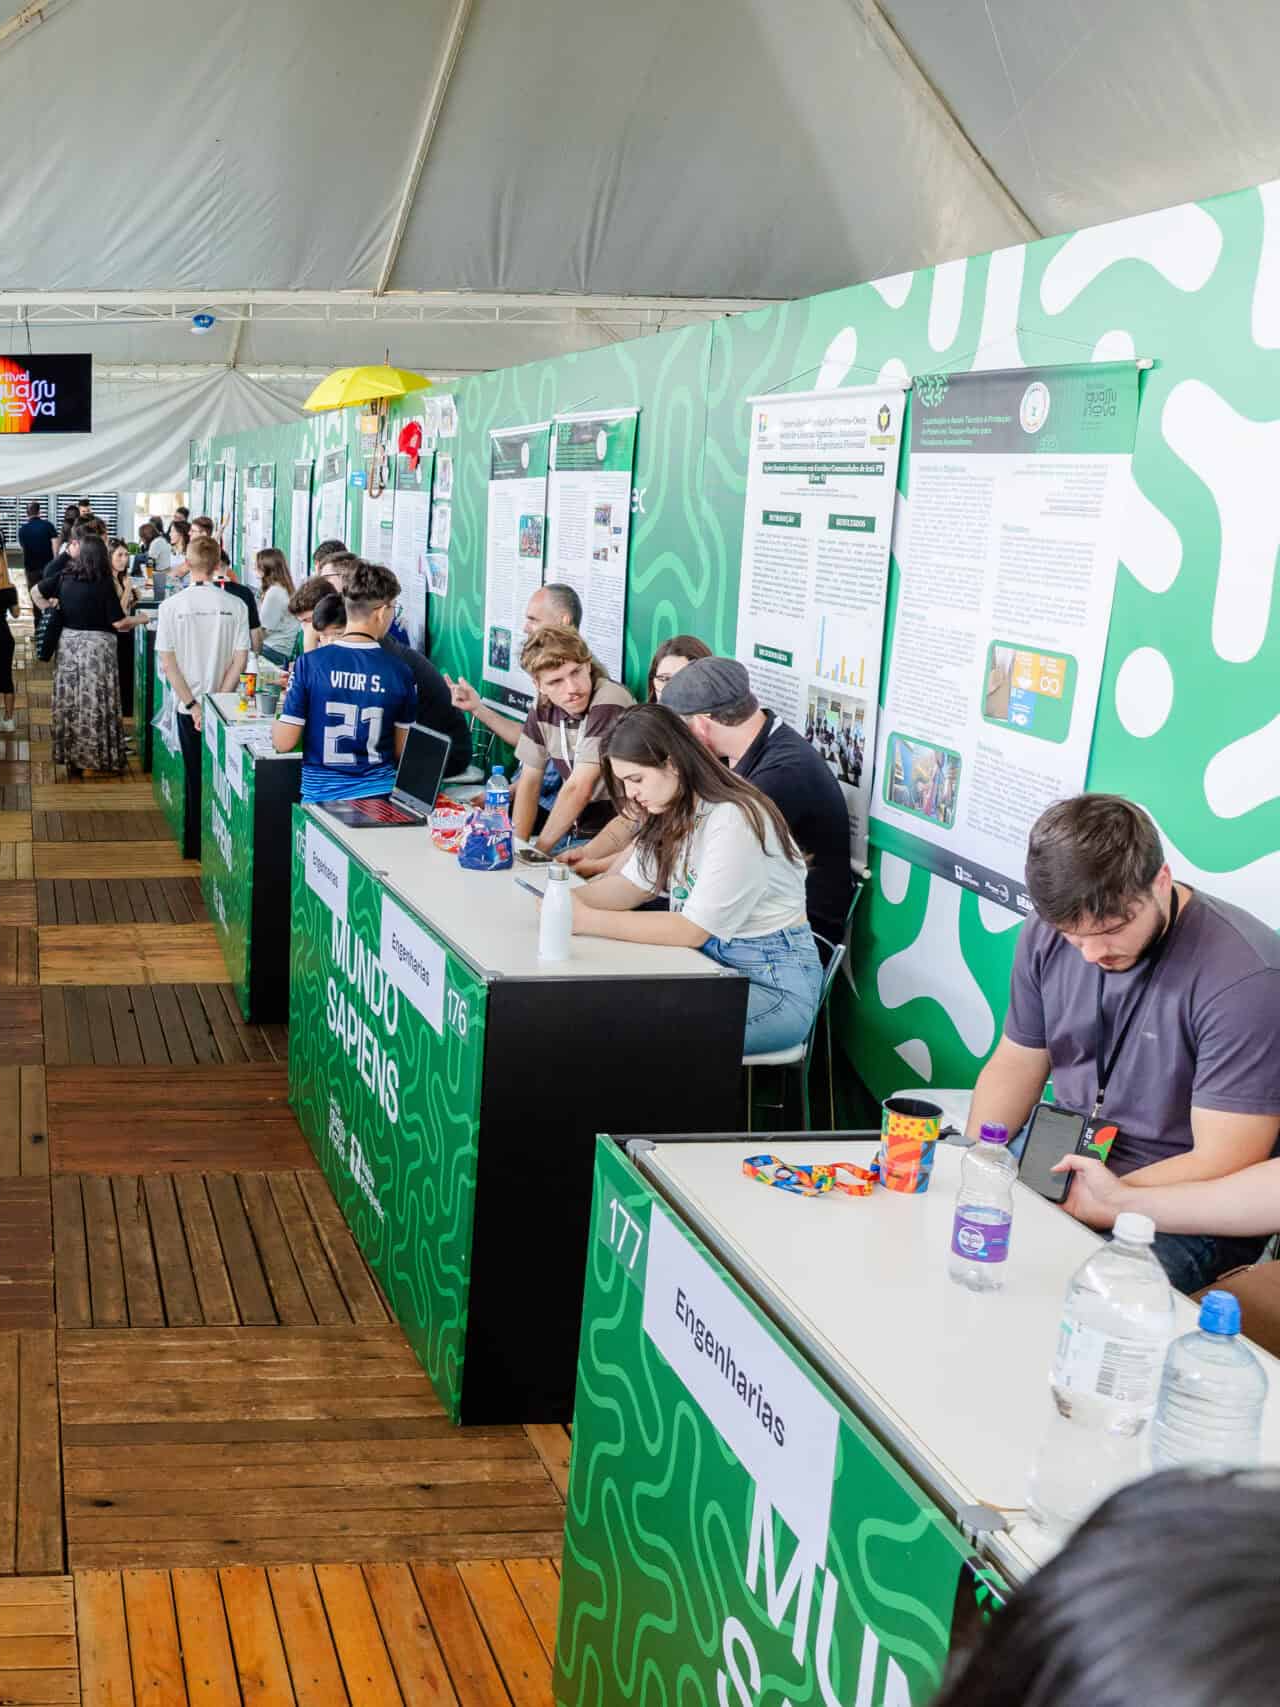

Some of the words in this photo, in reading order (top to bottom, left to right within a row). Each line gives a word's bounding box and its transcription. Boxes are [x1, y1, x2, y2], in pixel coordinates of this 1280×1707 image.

[330, 670, 367, 692] VITOR
[370, 674, 386, 693] S.
[323, 701, 384, 766] 21
[332, 913, 399, 1036] MUNDO
[392, 932, 431, 987] Engenharias
[447, 987, 468, 1036] 176
[326, 976, 400, 1124] SAPIENS
[609, 1197, 643, 1270] 177
[675, 1287, 785, 1448] Engenharias
